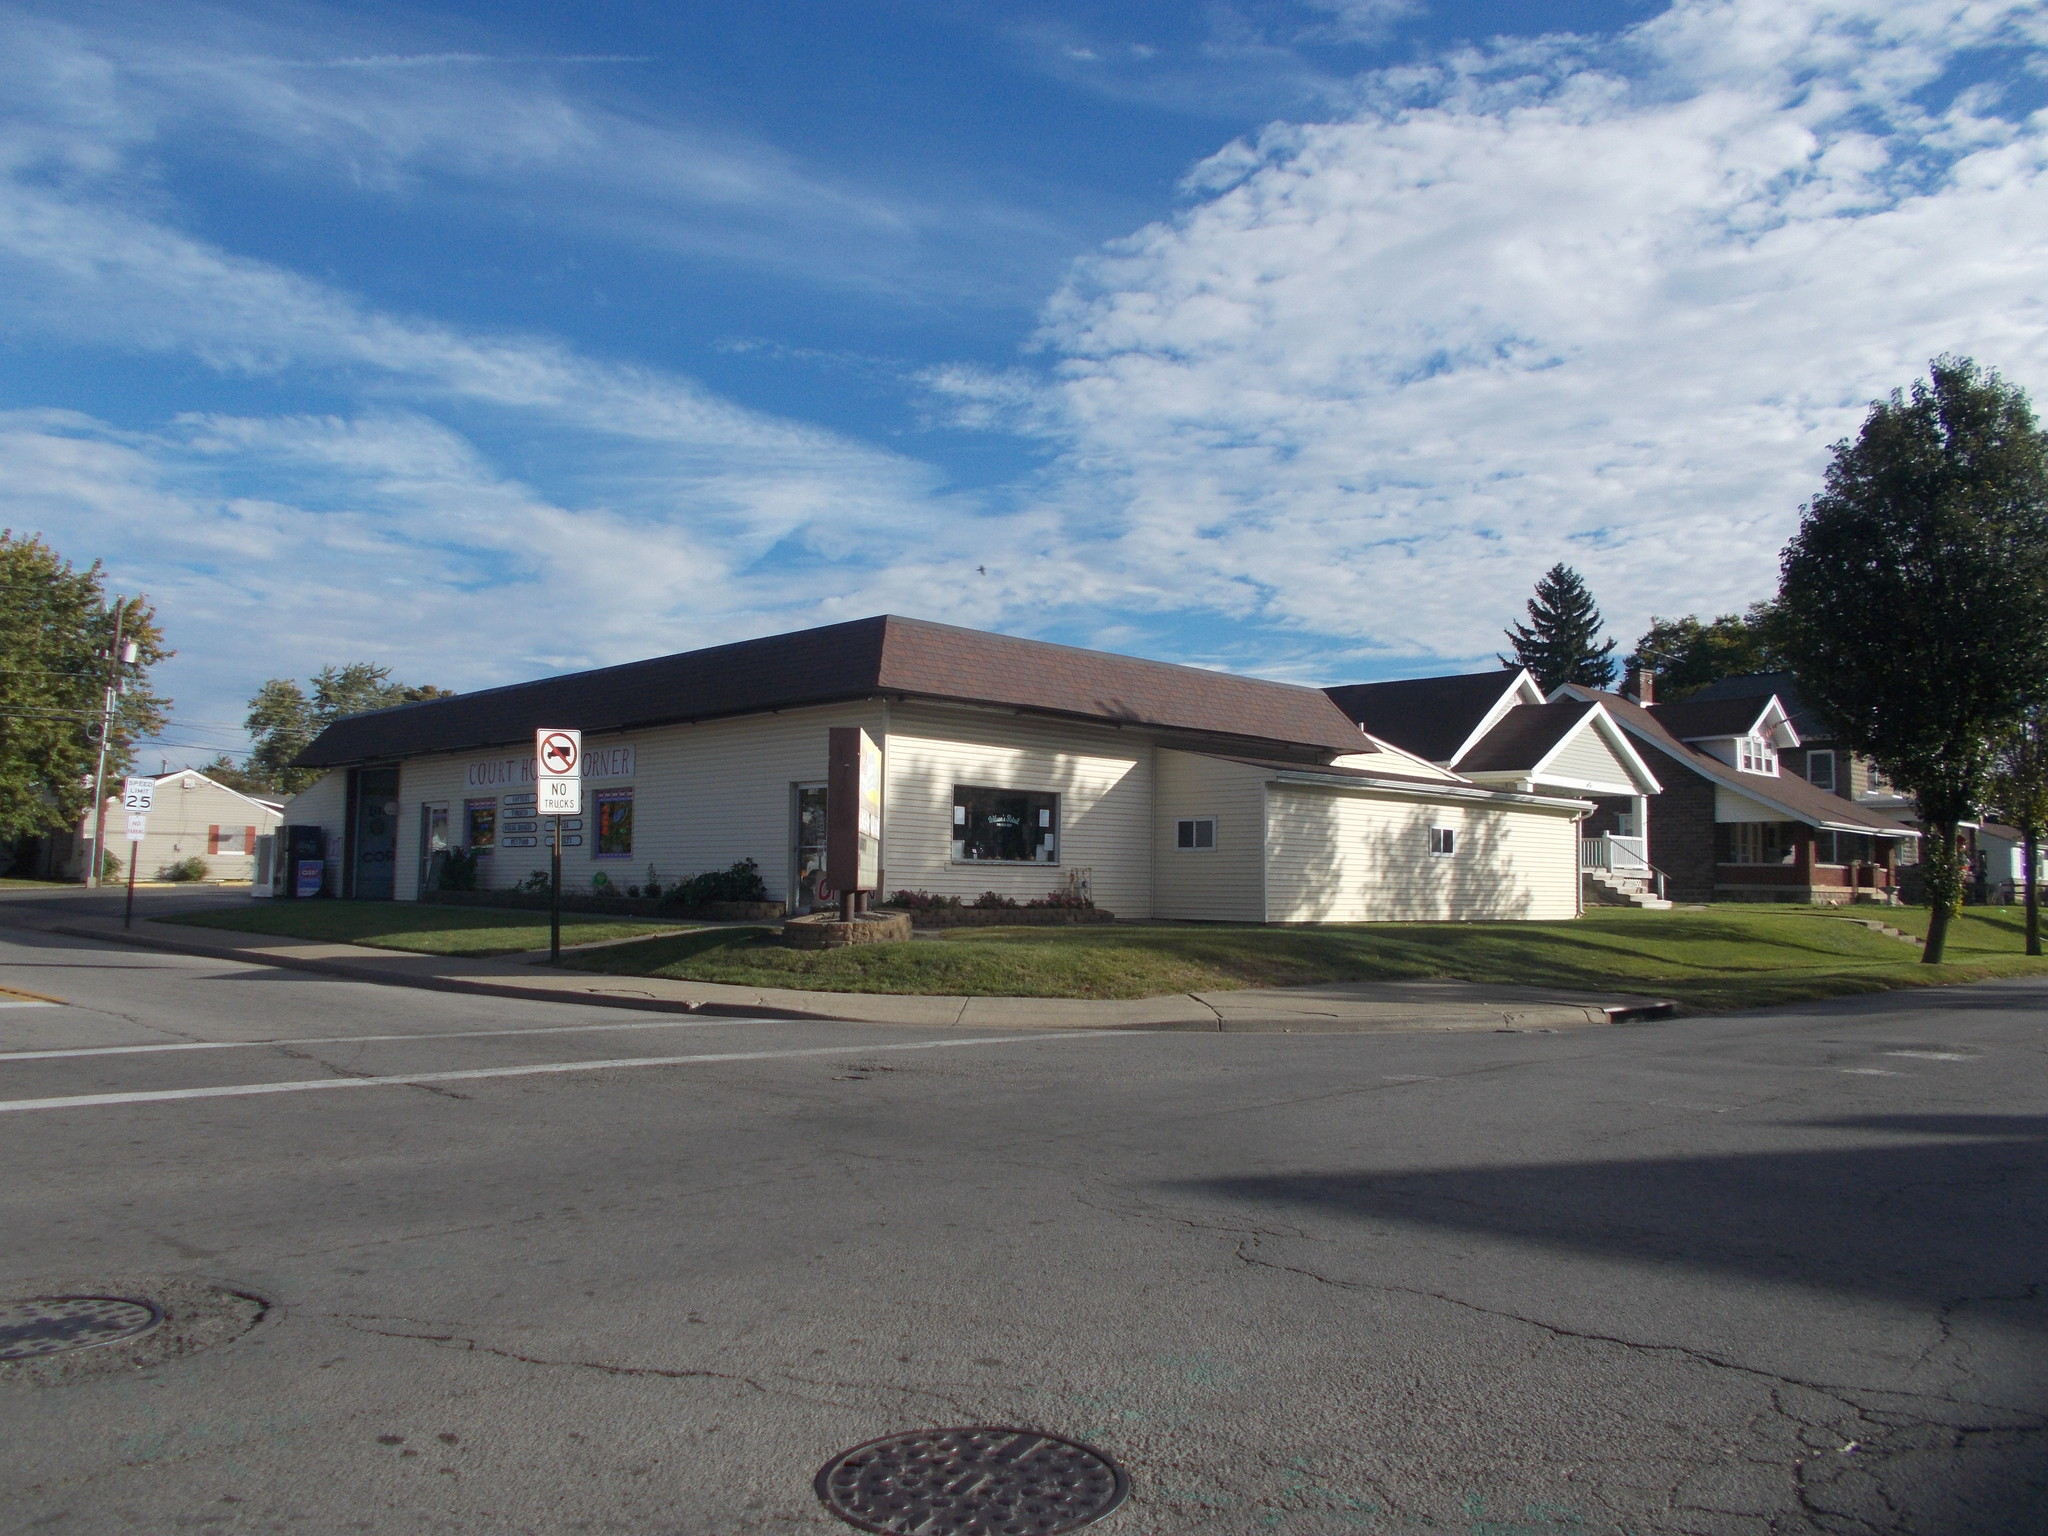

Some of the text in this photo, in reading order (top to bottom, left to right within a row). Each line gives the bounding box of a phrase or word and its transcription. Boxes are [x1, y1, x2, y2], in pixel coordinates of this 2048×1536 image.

[469, 760, 515, 785] COURT
[582, 748, 630, 777] ORNER
[551, 783, 567, 796] NO
[126, 795, 151, 808] 25
[544, 799, 575, 809] TRUCKS
